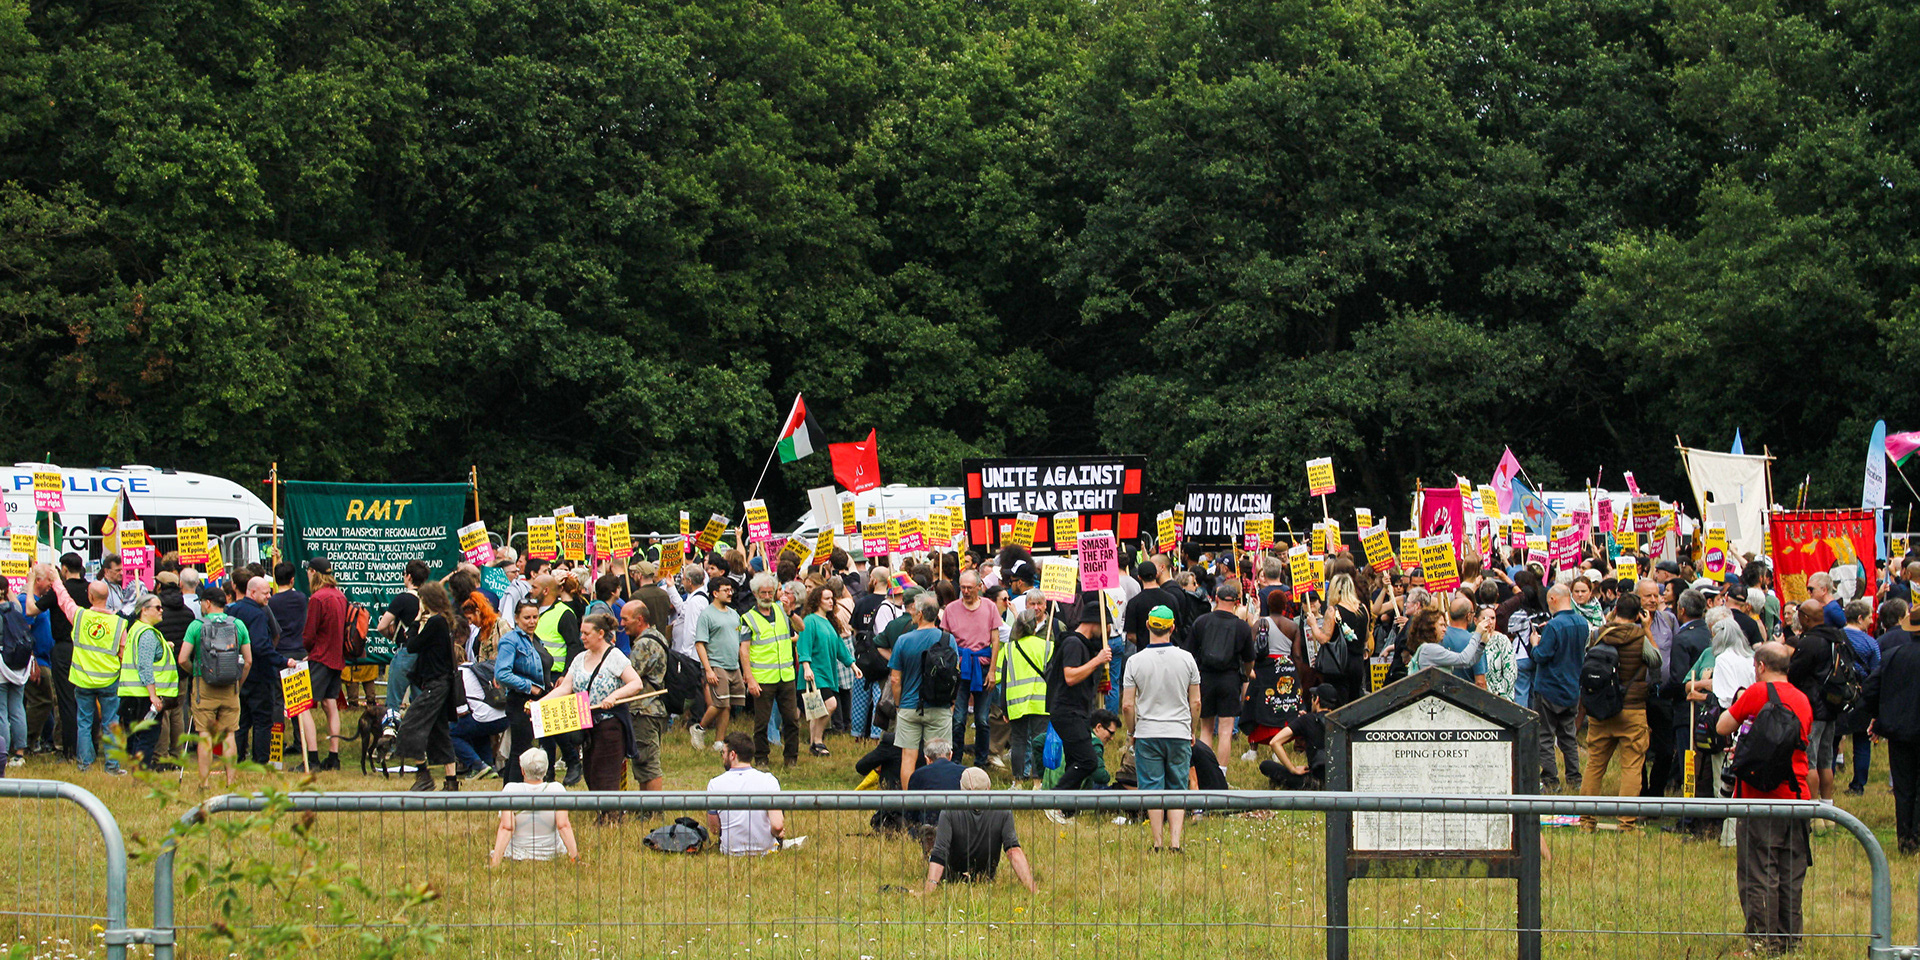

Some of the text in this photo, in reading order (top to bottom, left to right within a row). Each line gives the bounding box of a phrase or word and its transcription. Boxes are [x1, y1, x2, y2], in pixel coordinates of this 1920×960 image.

[982, 465, 1124, 488] UNITE AGAINST
[14, 475, 150, 492] PLICE
[36, 491, 60, 500] Stop the
[988, 492, 1022, 512] THE
[1025, 490, 1058, 511] FAR
[1062, 489, 1117, 510] RIGHT
[48, 500, 60, 508] right
[1187, 493, 1272, 512] NO TO RACISM
[346, 498, 412, 520] RMT
[863, 523, 886, 531] Refugees
[1185, 517, 1202, 535] NO
[1206, 517, 1220, 535] TO
[1223, 517, 1245, 535] HAT
[1785, 522, 1862, 540] NEWHAM
[303, 526, 446, 538] LONDON TRANSPORT REGIONAL COUNCIL
[1372, 533, 1384, 542] right
[307, 542, 436, 551] FOR FULLY FINANCED PUBLICLY FINANCED
[663, 543, 679, 551] SMASH
[874, 546, 886, 554] right
[1082, 539, 1109, 551] SMASH
[1432, 544, 1448, 554] right
[1560, 541, 1579, 553] Refugees
[327, 552, 424, 560] DEMOCRATICALLY CONTROLLED
[662, 551, 680, 559] FASCISM
[1083, 549, 1114, 561] THE FAR
[1368, 546, 1389, 556] welcome
[1376, 552, 1392, 560] Epping
[1561, 548, 1579, 558] welcome
[330, 561, 365, 570] TEGRATED
[425, 560, 443, 568] OUND
[1083, 561, 1107, 573] RIGHT
[1425, 562, 1452, 571] welcome
[334, 572, 405, 581] PUBLIC TRANSPO
[1434, 569, 1456, 578] Epping
[352, 587, 383, 595] EQUALITY
[1050, 584, 1072, 593] Epping
[374, 602, 379, 611] 4
[293, 672, 305, 681] right
[286, 686, 308, 698] welcome
[294, 693, 311, 704] Epping
[542, 704, 550, 720] right
[560, 701, 569, 729] welcome
[569, 697, 578, 728] in Epping
[1366, 731, 1499, 741] CORPORATION OF LONDON
[1395, 750, 1469, 758] EPPING FOREST
